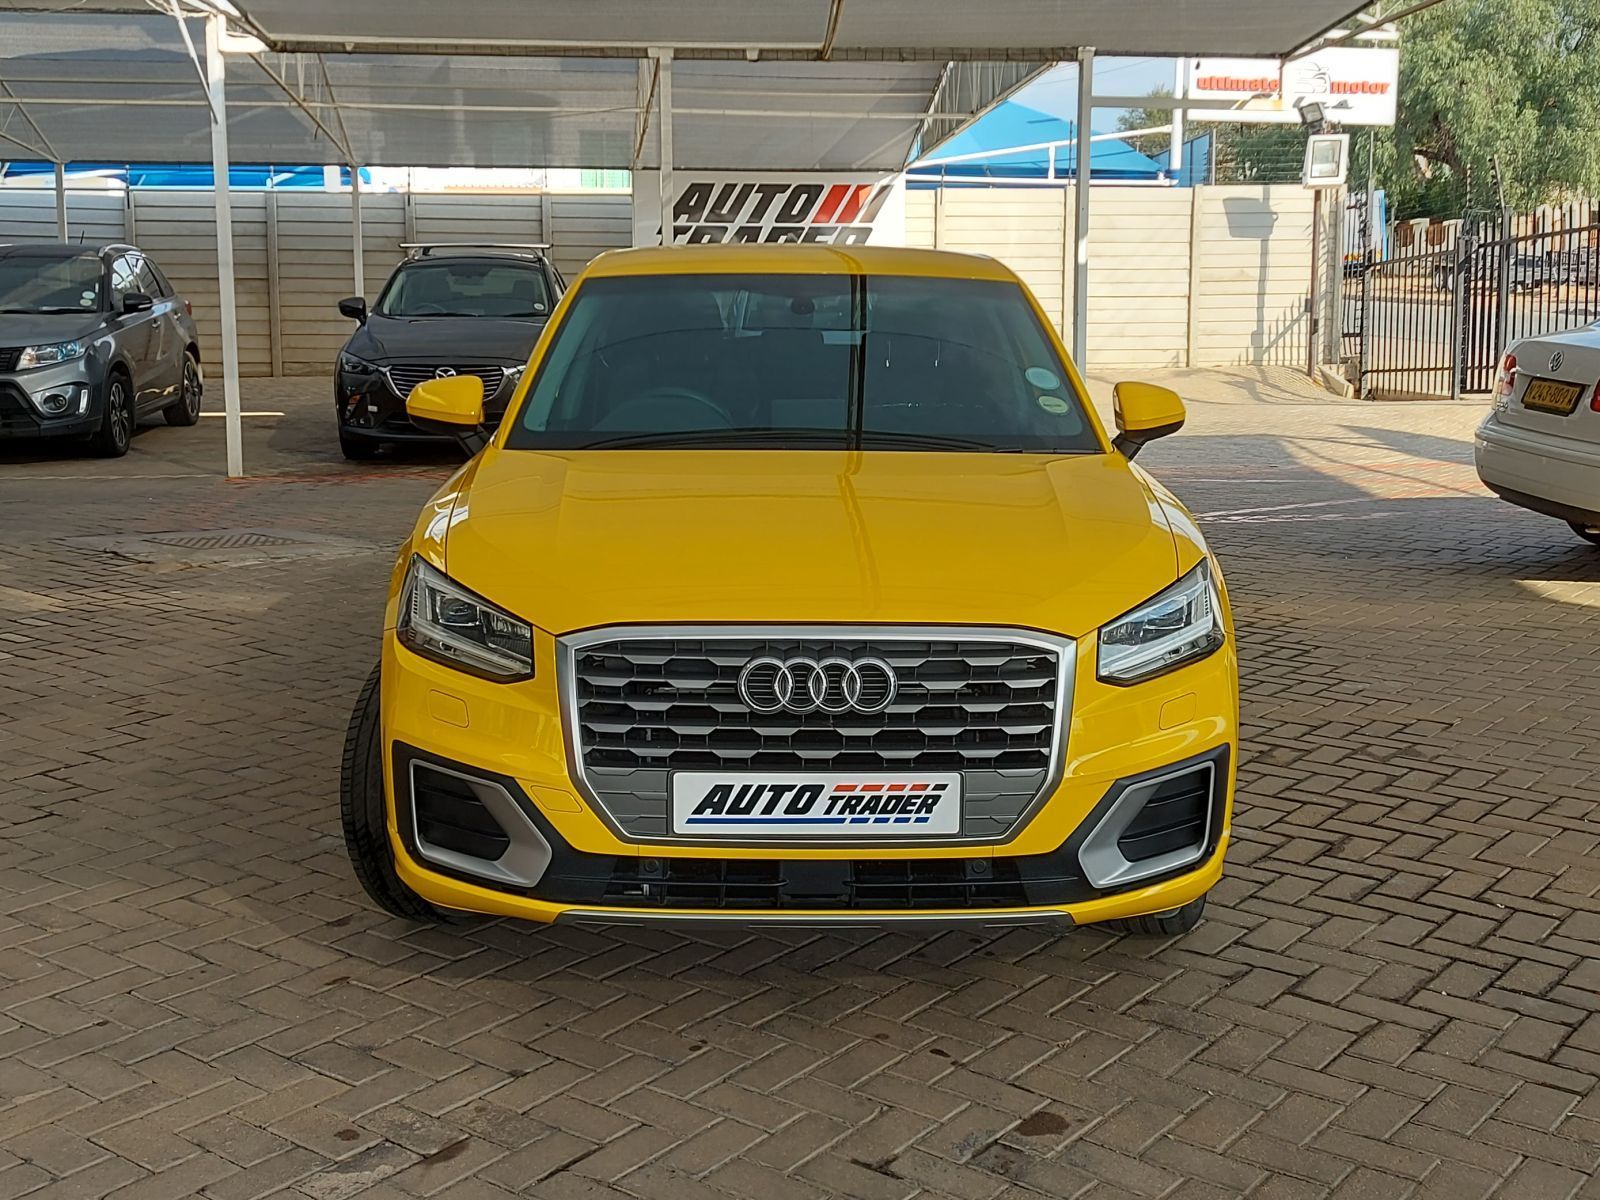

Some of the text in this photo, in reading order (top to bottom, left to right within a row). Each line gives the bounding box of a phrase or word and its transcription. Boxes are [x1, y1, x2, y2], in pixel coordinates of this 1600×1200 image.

[1196, 75, 1391, 95] ultimate motor
[672, 182, 825, 224] AUTO
[691, 783, 942, 816] AUTO TRADER
